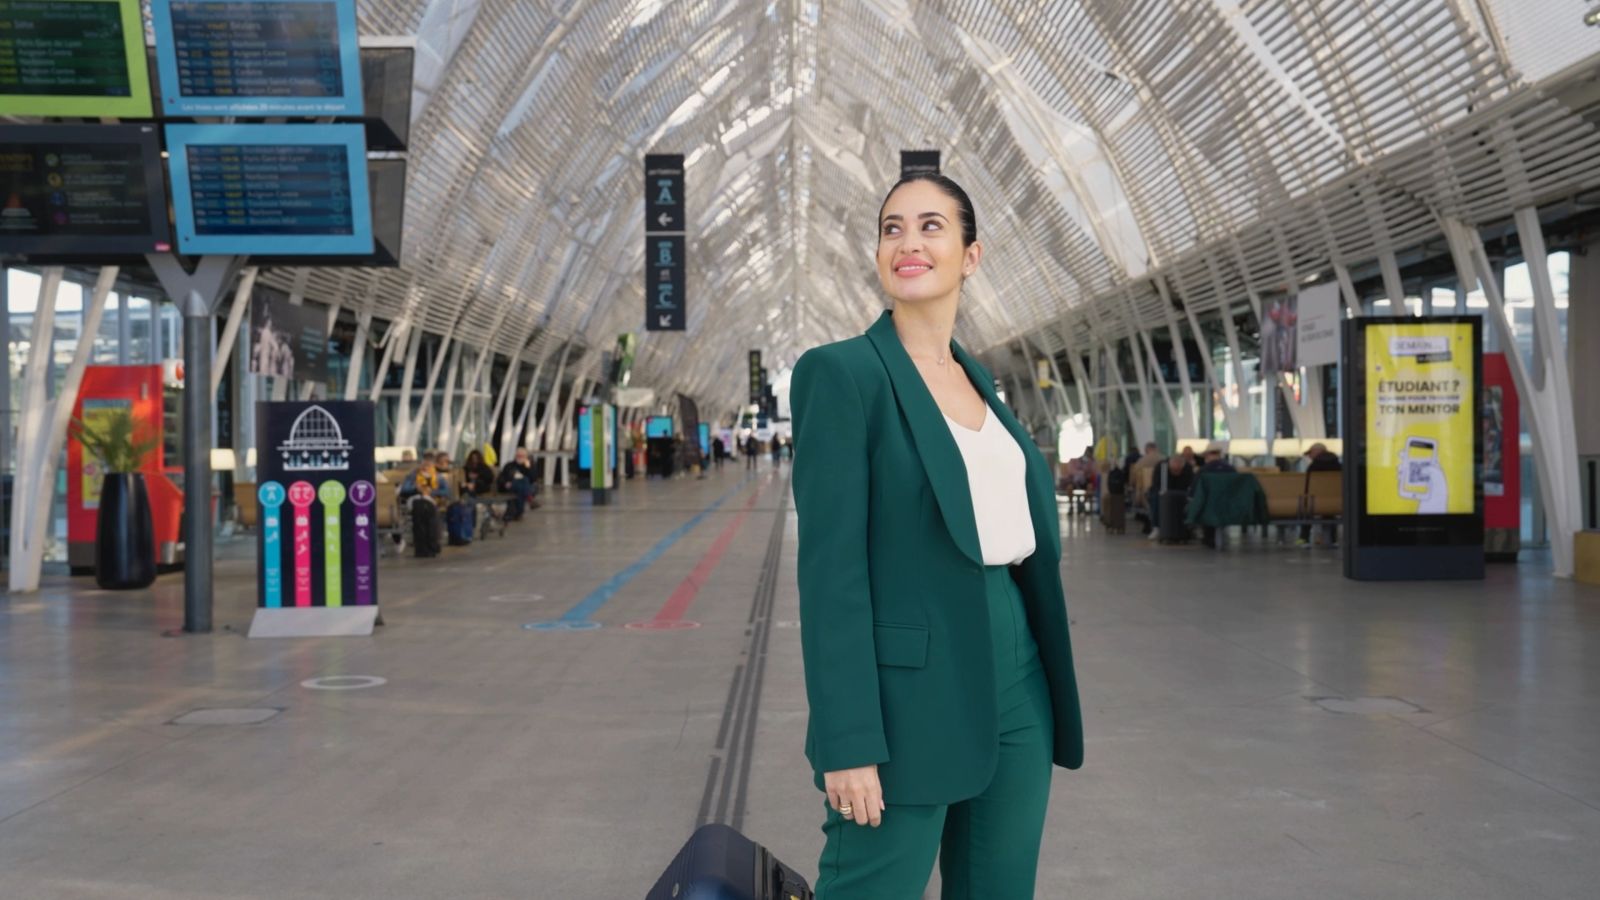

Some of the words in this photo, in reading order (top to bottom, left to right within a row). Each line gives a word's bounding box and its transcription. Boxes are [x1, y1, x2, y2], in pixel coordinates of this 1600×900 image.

[657, 187, 673, 202] A
[660, 248, 672, 264] B
[659, 290, 673, 306] C
[1378, 378, 1449, 393] ÉTUDIANT
[1453, 380, 1460, 392] ?
[1379, 404, 1405, 415] TON
[1408, 404, 1460, 415] MENTOR
